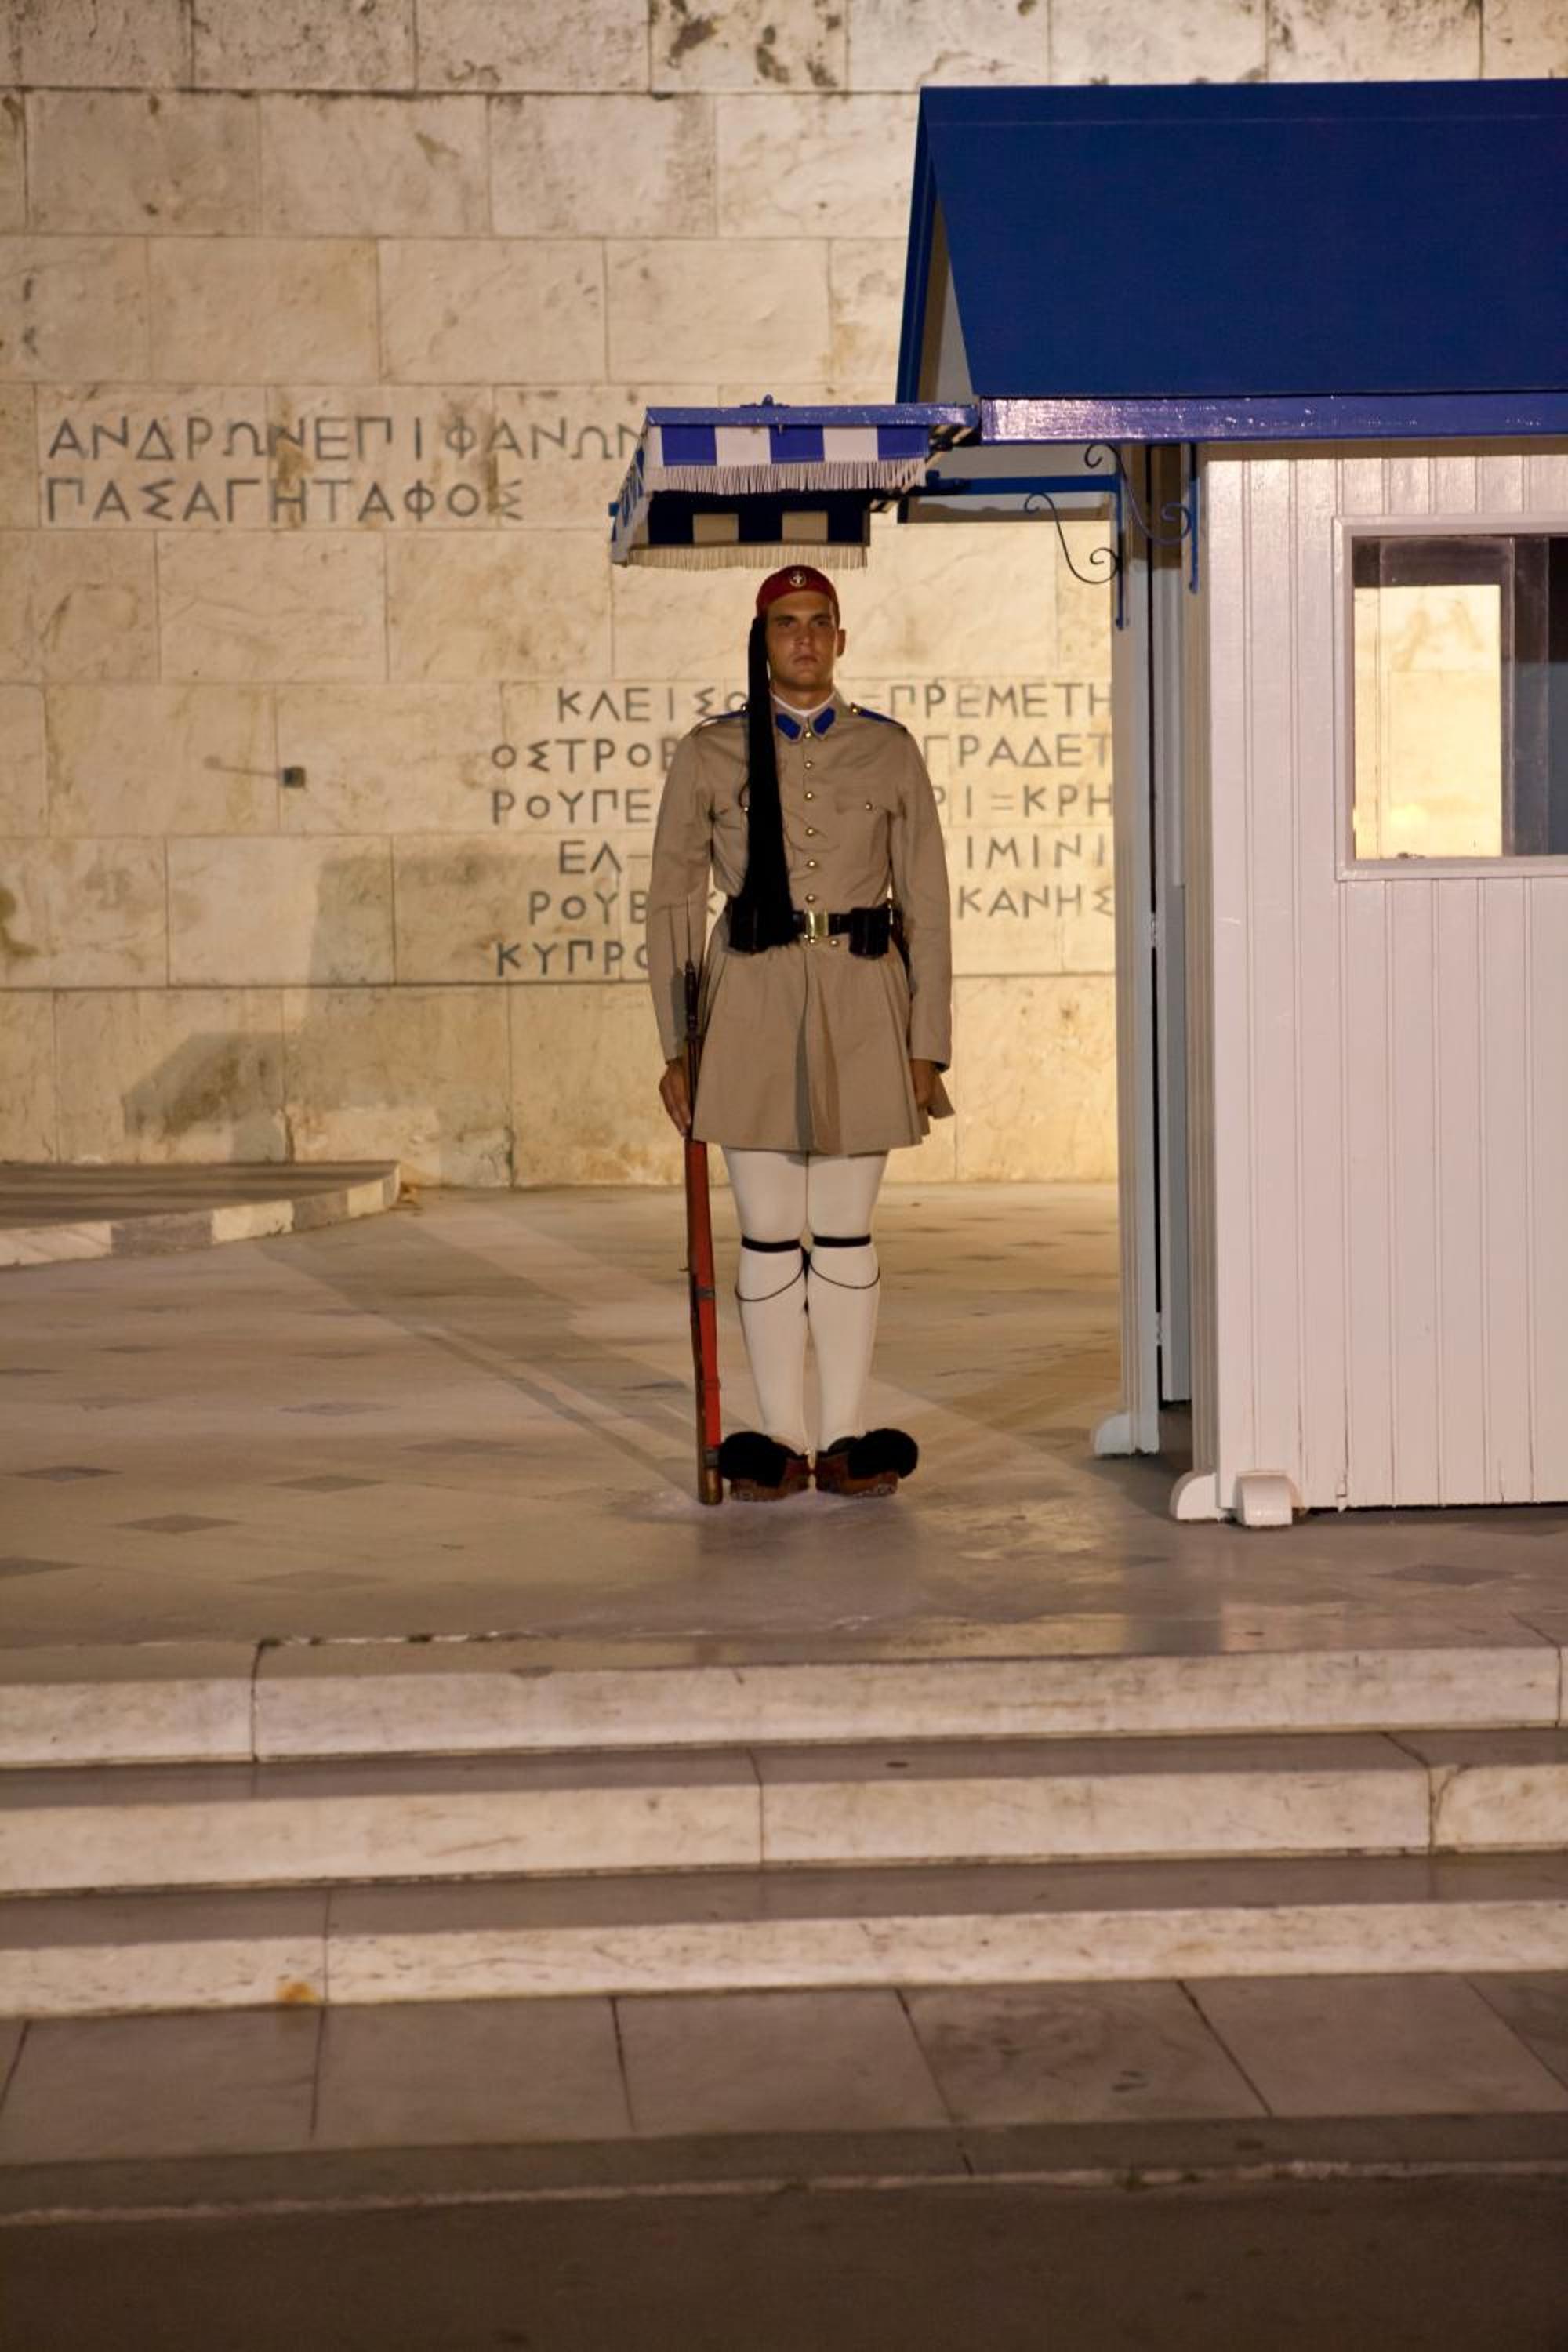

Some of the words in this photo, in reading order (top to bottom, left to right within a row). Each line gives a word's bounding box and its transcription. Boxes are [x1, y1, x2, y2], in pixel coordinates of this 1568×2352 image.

[492, 789, 651, 825] ΡΟΥΠΕ
[528, 890, 648, 925] ΡΟΥΒ
[958, 885, 1112, 920] ΚΑΝΗΣ
